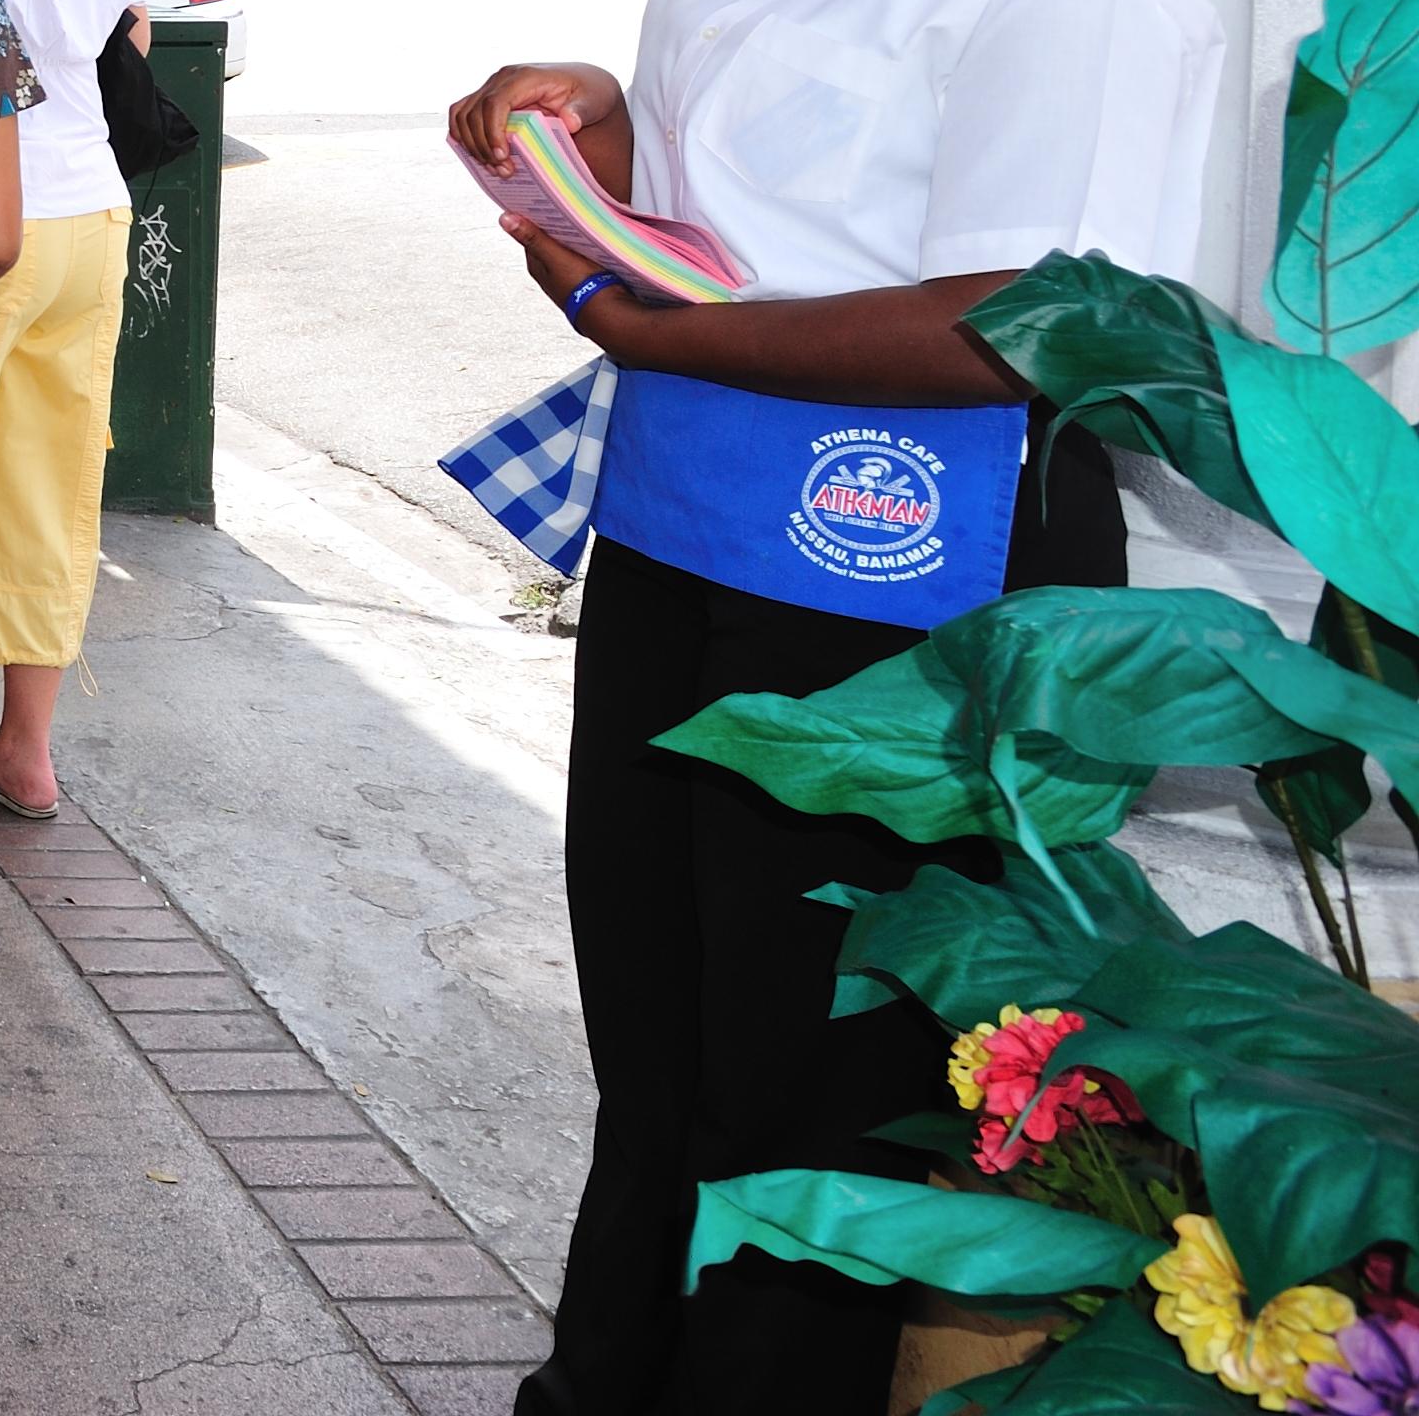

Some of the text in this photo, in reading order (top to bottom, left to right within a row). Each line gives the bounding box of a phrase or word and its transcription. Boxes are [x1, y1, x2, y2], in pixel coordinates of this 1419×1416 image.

[811, 429, 946, 474] ATHENA CAFE
[813, 484, 932, 525] ATHENIAN
[789, 511, 943, 568] NASSAU, BAHAMAS
